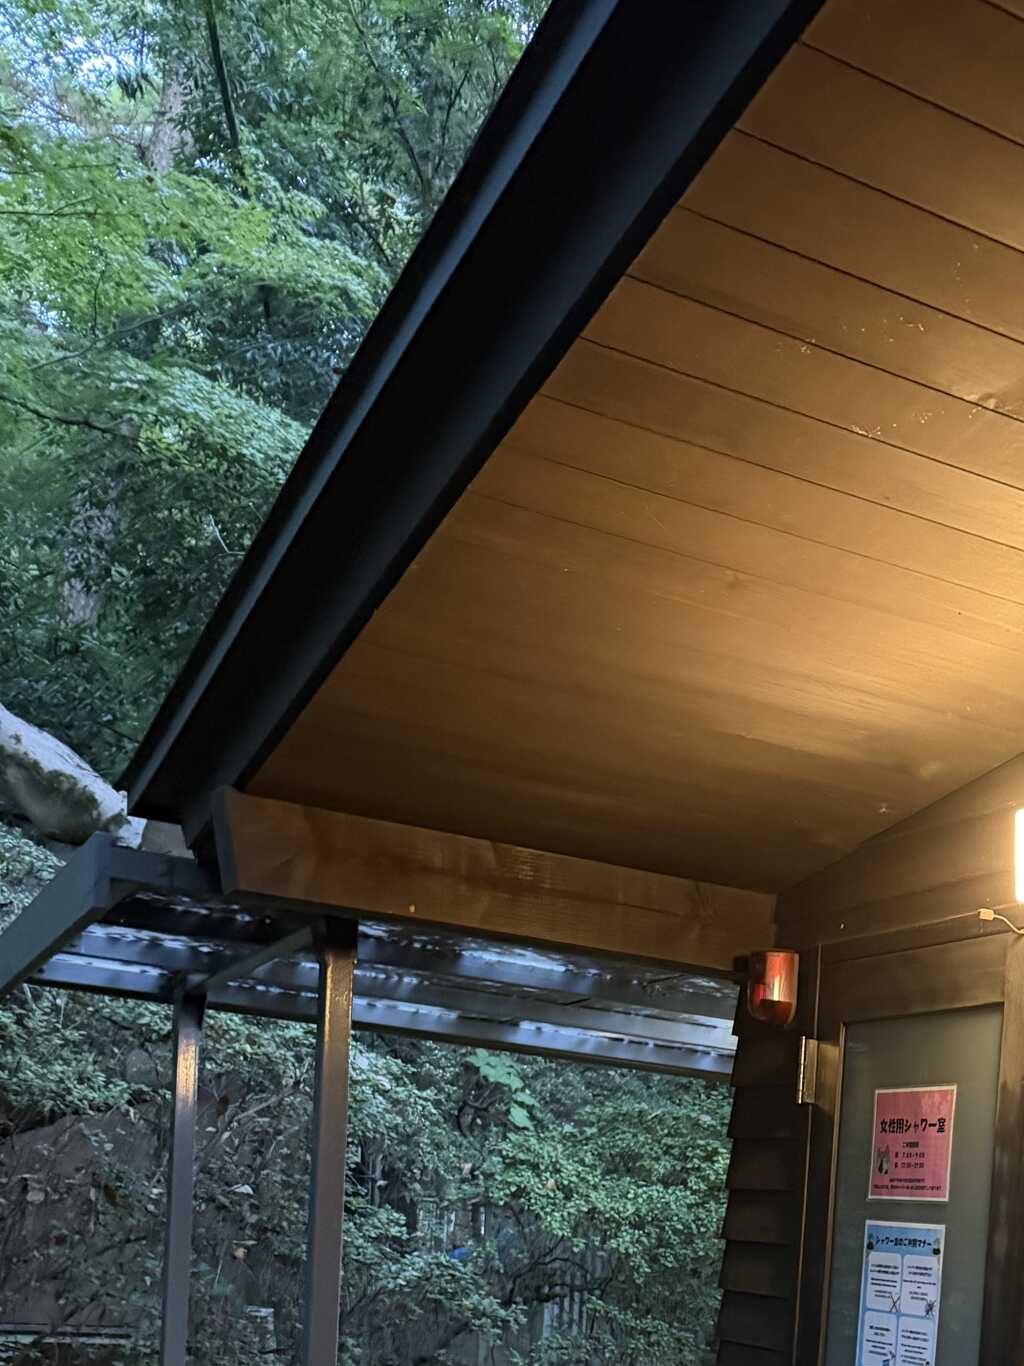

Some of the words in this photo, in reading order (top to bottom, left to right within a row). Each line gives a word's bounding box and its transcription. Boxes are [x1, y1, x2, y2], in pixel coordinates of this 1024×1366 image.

[879, 1117, 946, 1135] 女性用シャワー室
